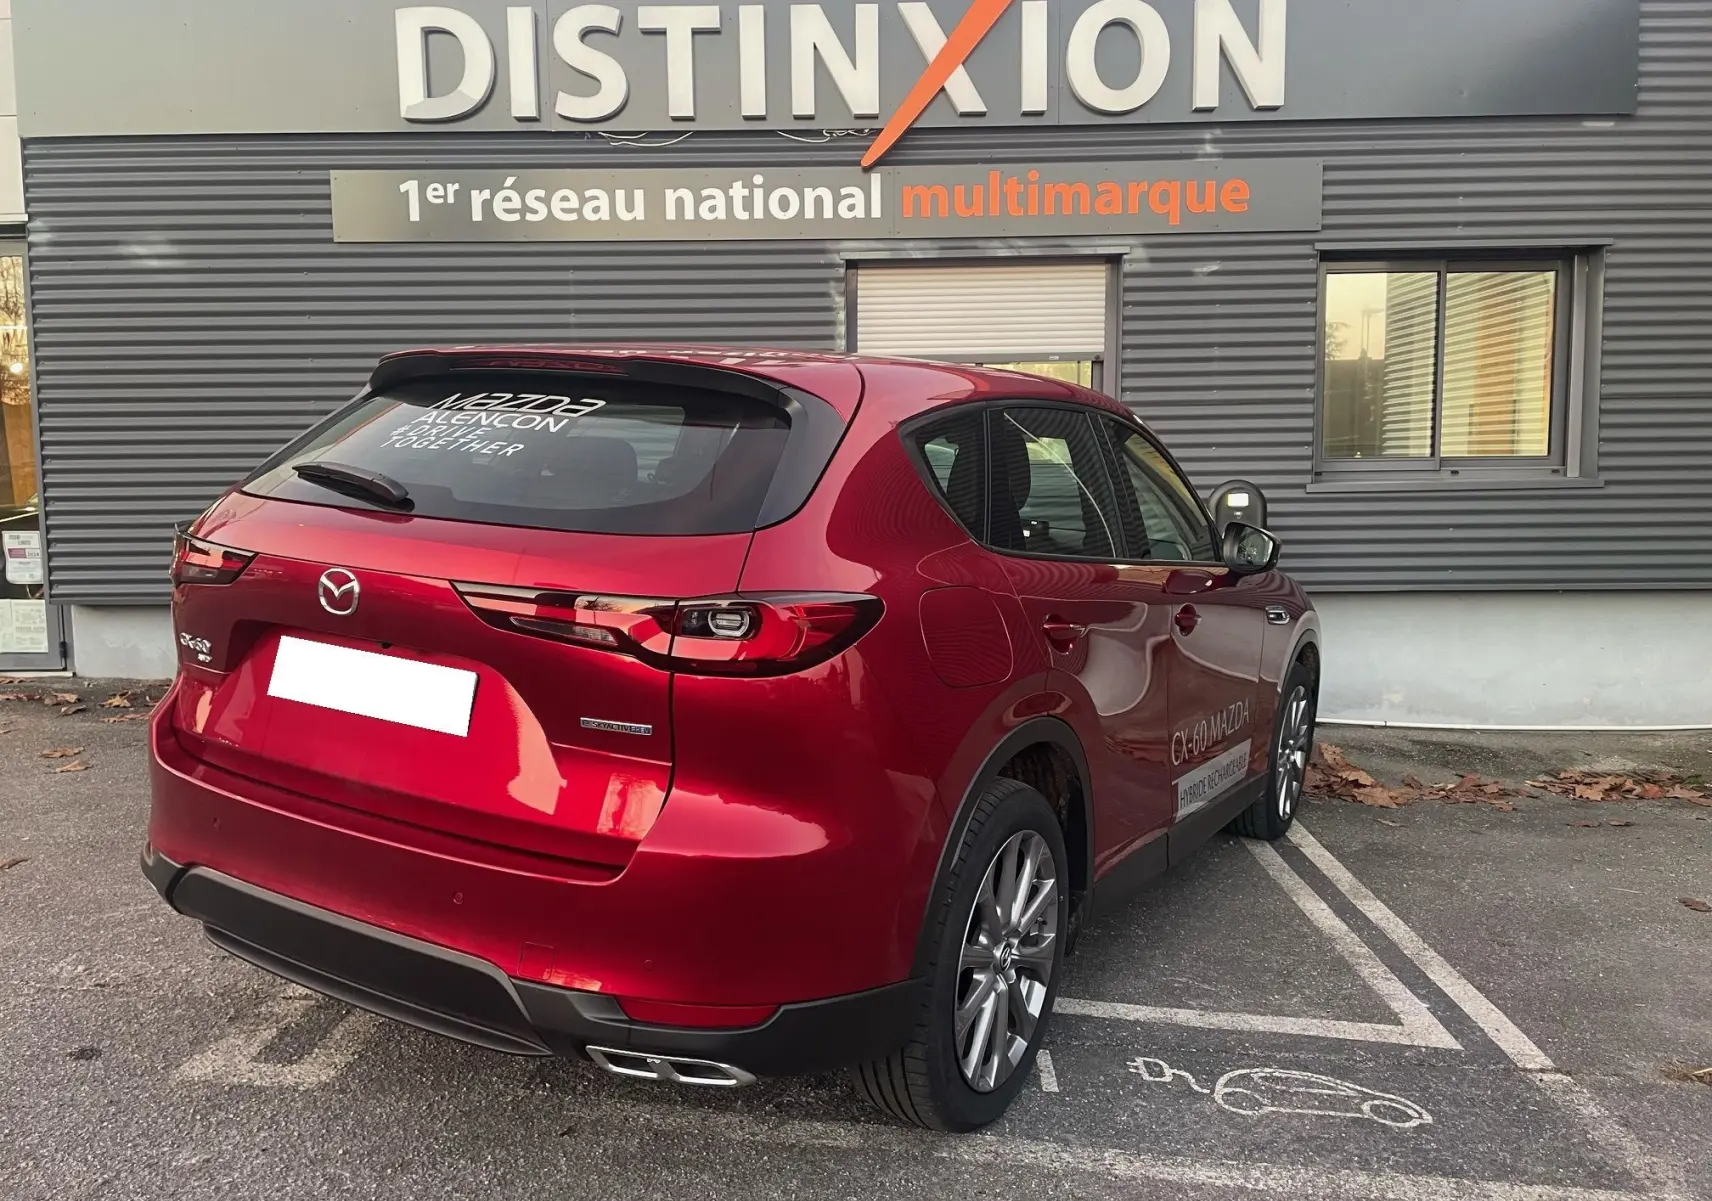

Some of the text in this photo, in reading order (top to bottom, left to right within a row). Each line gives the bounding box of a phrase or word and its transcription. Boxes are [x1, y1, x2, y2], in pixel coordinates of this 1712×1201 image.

[394, 0, 1287, 167] DISTINXION
[399, 170, 1250, 225] 1er réseau national multimarque
[380, 436, 525, 457] TOGETHER
[411, 411, 569, 433] ALENÇON
[1171, 697, 1250, 766] CX-60 MAZDA
[1179, 752, 1248, 809] HYBRIDE RECHARGEABLE
